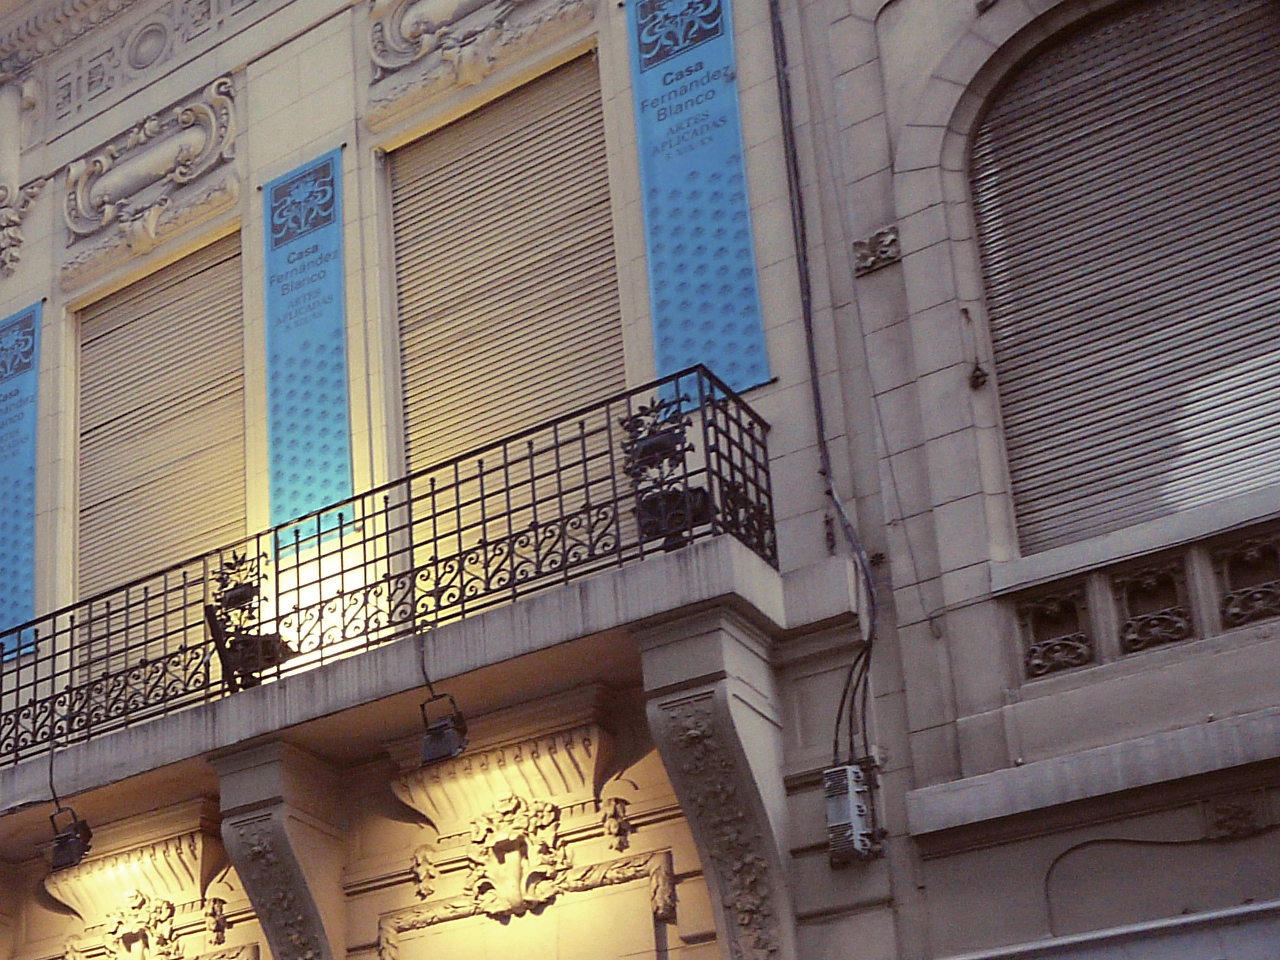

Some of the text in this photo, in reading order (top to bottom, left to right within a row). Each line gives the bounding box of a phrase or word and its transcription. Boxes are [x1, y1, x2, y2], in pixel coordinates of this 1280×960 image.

[662, 61, 704, 86] Casa
[656, 89, 716, 122] Blanco
[287, 244, 319, 265] Casa
[281, 269, 327, 296] Blanco
